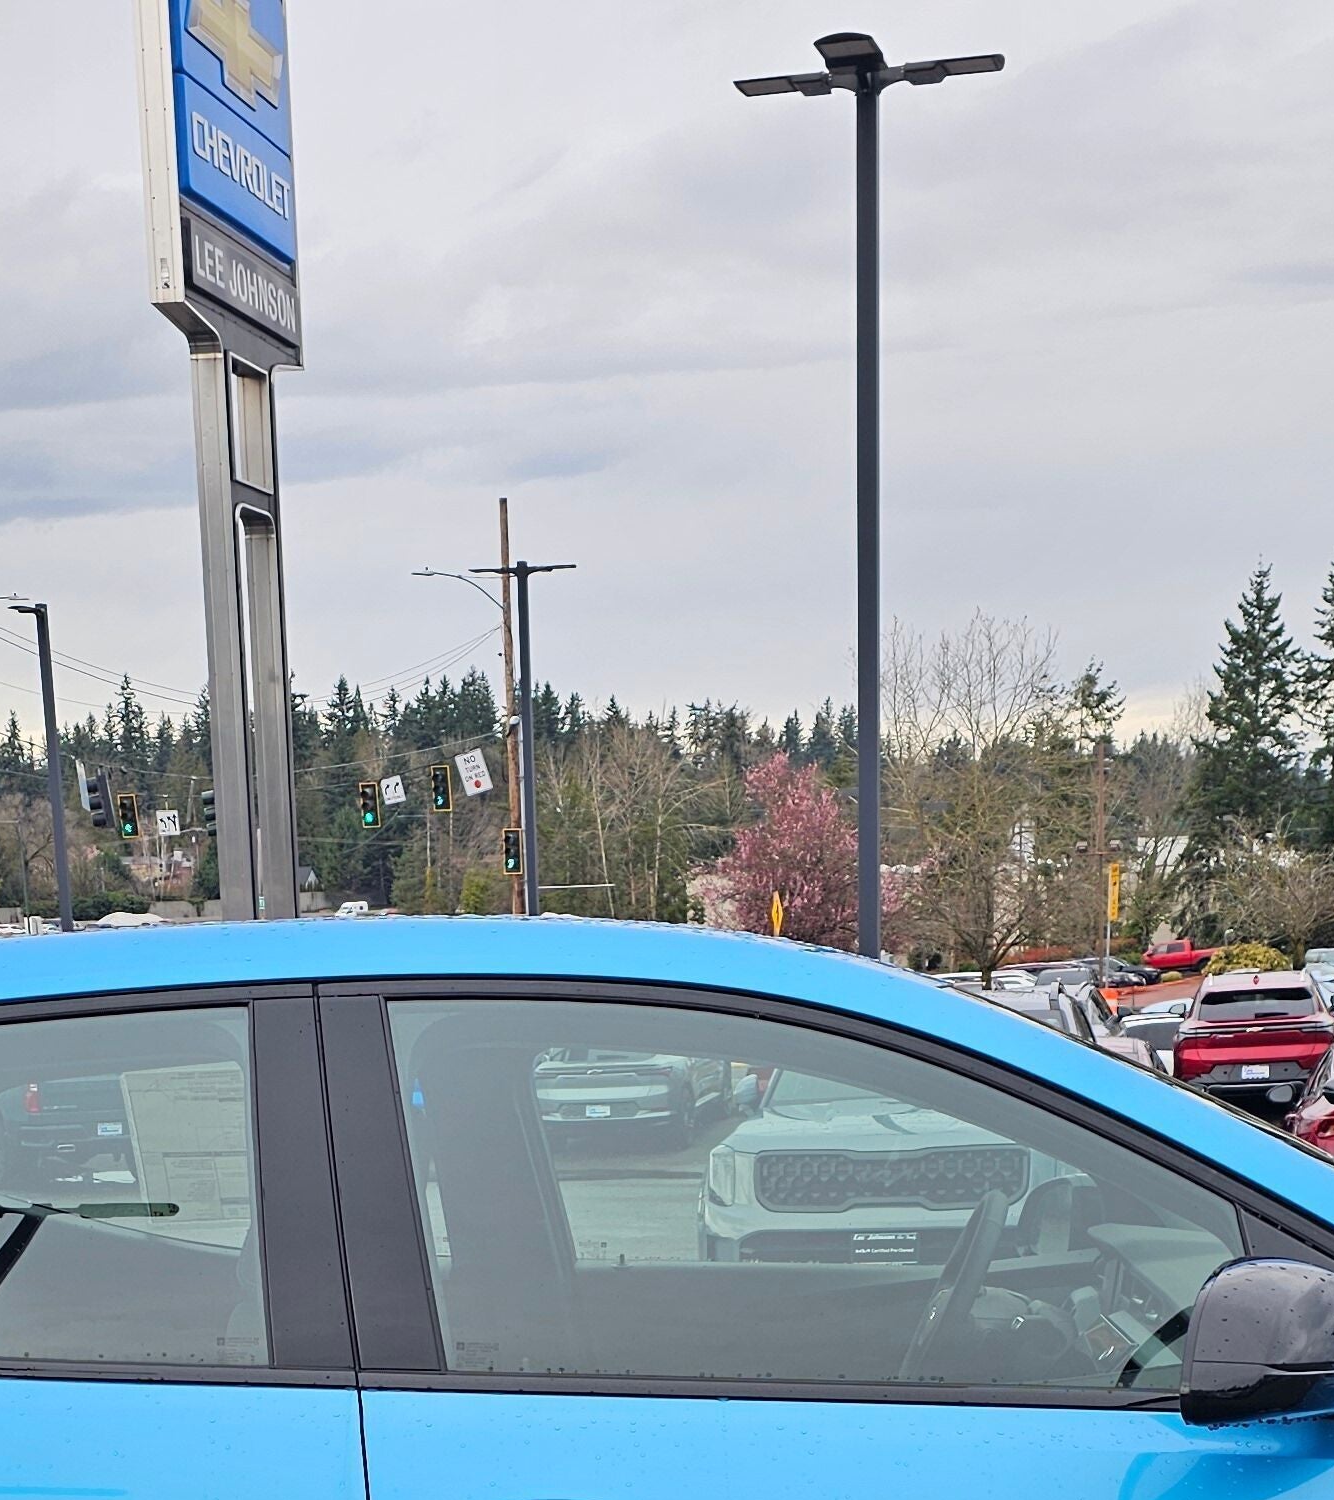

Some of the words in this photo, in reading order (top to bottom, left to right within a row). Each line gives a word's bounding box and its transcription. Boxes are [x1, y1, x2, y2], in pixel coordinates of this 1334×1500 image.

[191, 110, 291, 221] CHEVROLET
[194, 234, 226, 290] LEE
[229, 259, 298, 334] JOHNSON
[464, 755, 476, 764] NO
